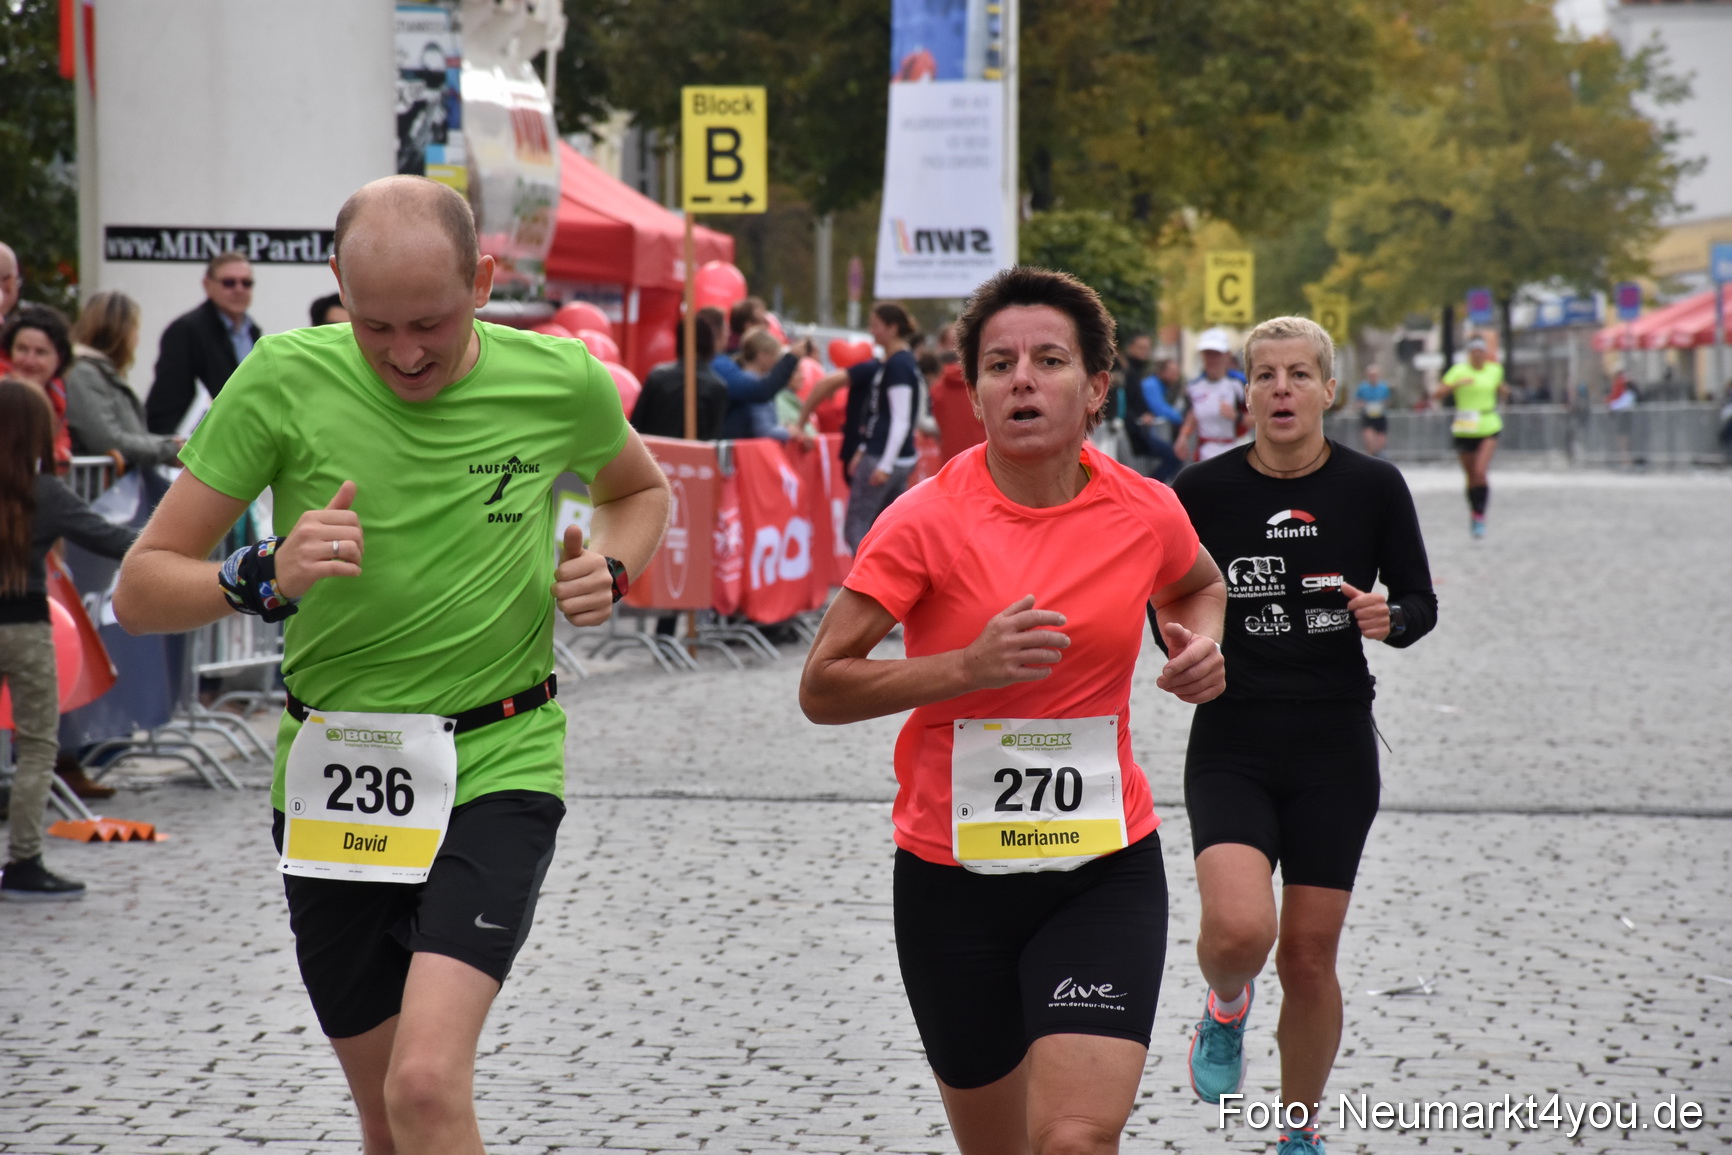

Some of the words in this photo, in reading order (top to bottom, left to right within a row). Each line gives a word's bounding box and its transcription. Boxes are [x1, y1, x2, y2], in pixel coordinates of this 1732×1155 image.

[692, 93, 756, 116] Block
[706, 127, 744, 183] B
[1217, 272, 1241, 306] C
[487, 512, 524, 524] DAVID
[1265, 525, 1319, 539] skinfit
[1305, 612, 1351, 628] ROCK
[344, 729, 403, 745] BOCK
[1017, 733, 1072, 746] BOCK
[323, 763, 415, 817] 236
[993, 766, 1083, 812] 270
[294, 802, 301, 811] D
[343, 832, 388, 853] David
[1000, 829, 1080, 847] Marianne
[1053, 976, 1128, 1000] live
